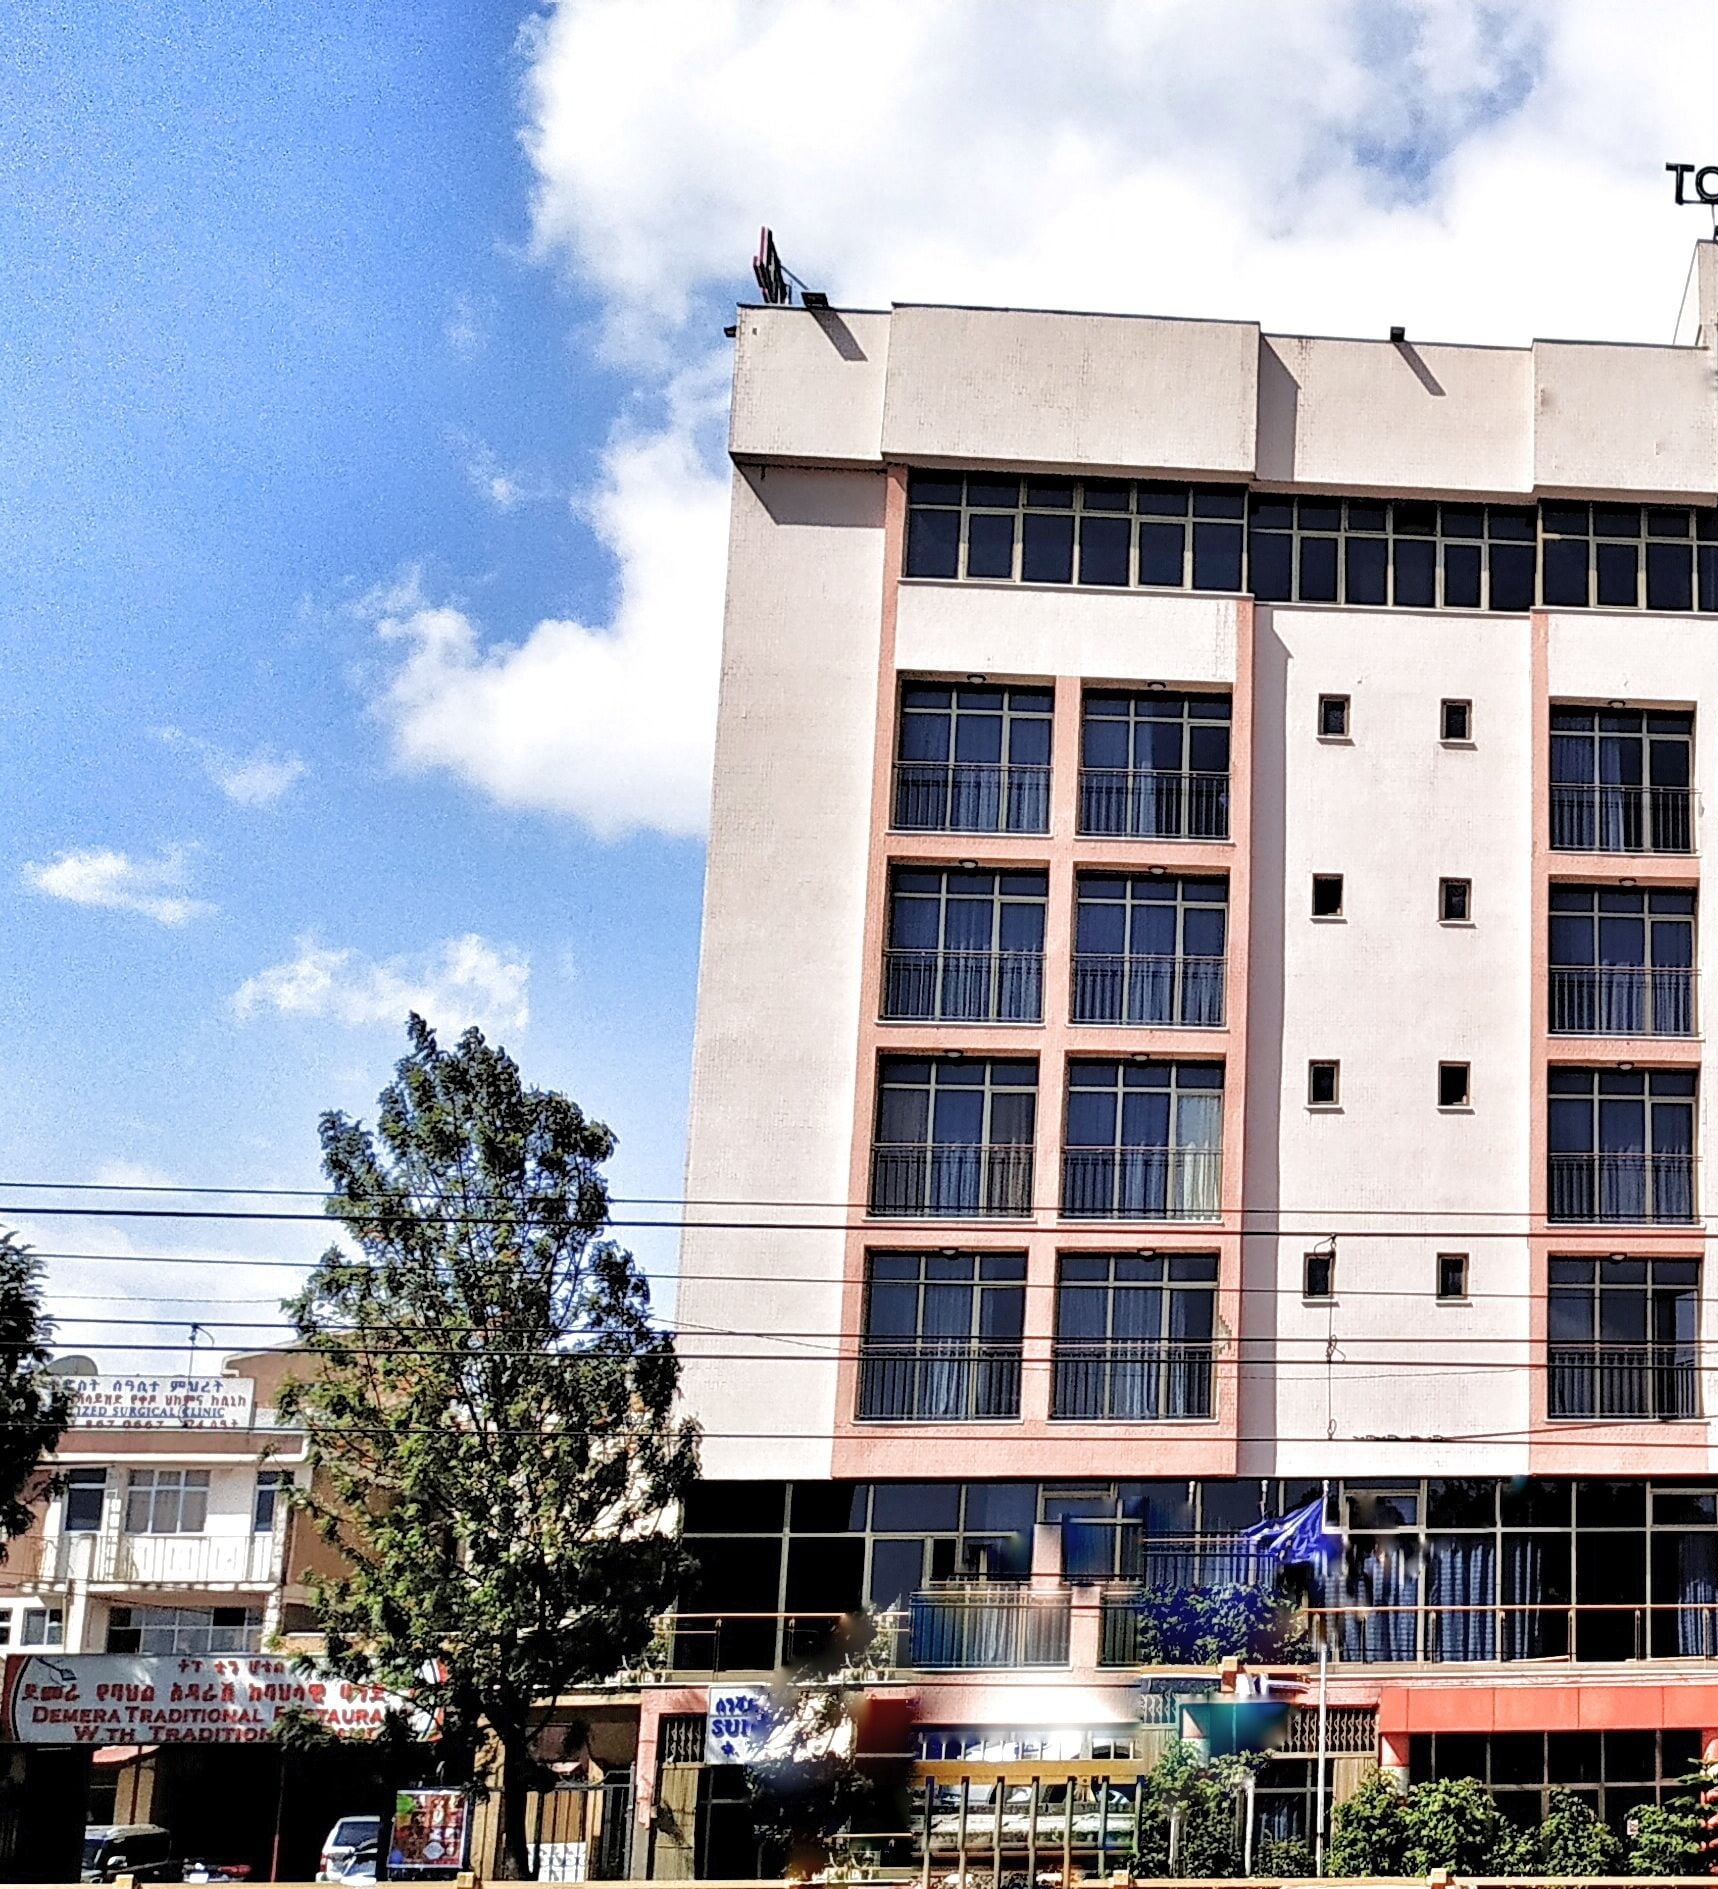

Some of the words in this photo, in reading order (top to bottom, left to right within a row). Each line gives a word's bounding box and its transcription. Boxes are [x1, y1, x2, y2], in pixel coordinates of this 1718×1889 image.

[112, 1406, 176, 1418] SURGICAL
[182, 1406, 225, 1418] CLINIC
[31, 1706, 120, 1723] DEMERA
[125, 1706, 264, 1723] TRADITIONAL
